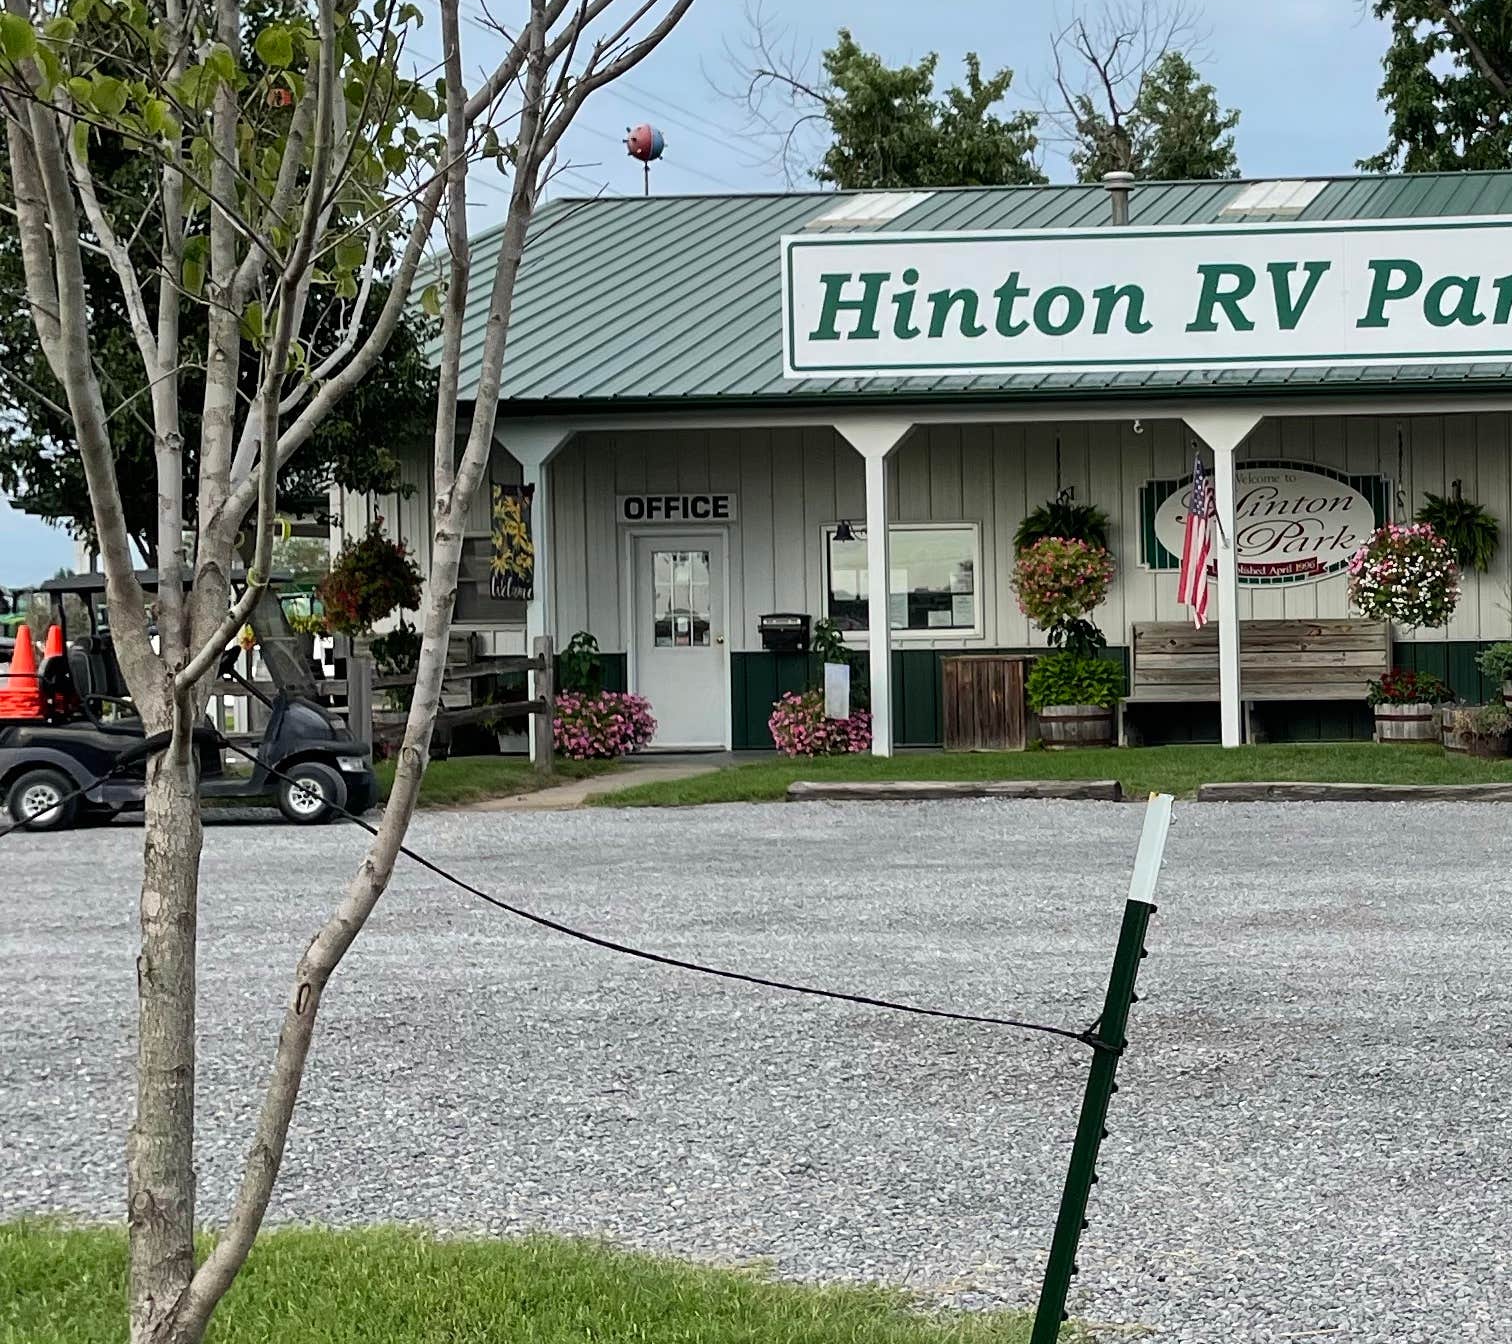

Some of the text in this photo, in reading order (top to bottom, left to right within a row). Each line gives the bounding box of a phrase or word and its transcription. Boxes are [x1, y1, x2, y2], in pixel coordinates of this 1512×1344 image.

[808, 268, 1153, 342] Hinton
[1185, 259, 1331, 333] RV
[1285, 474, 1297, 484] to
[624, 496, 729, 520] OFFICE
[1237, 517, 1356, 557] Park
[1237, 560, 1316, 576] lished April 1996
